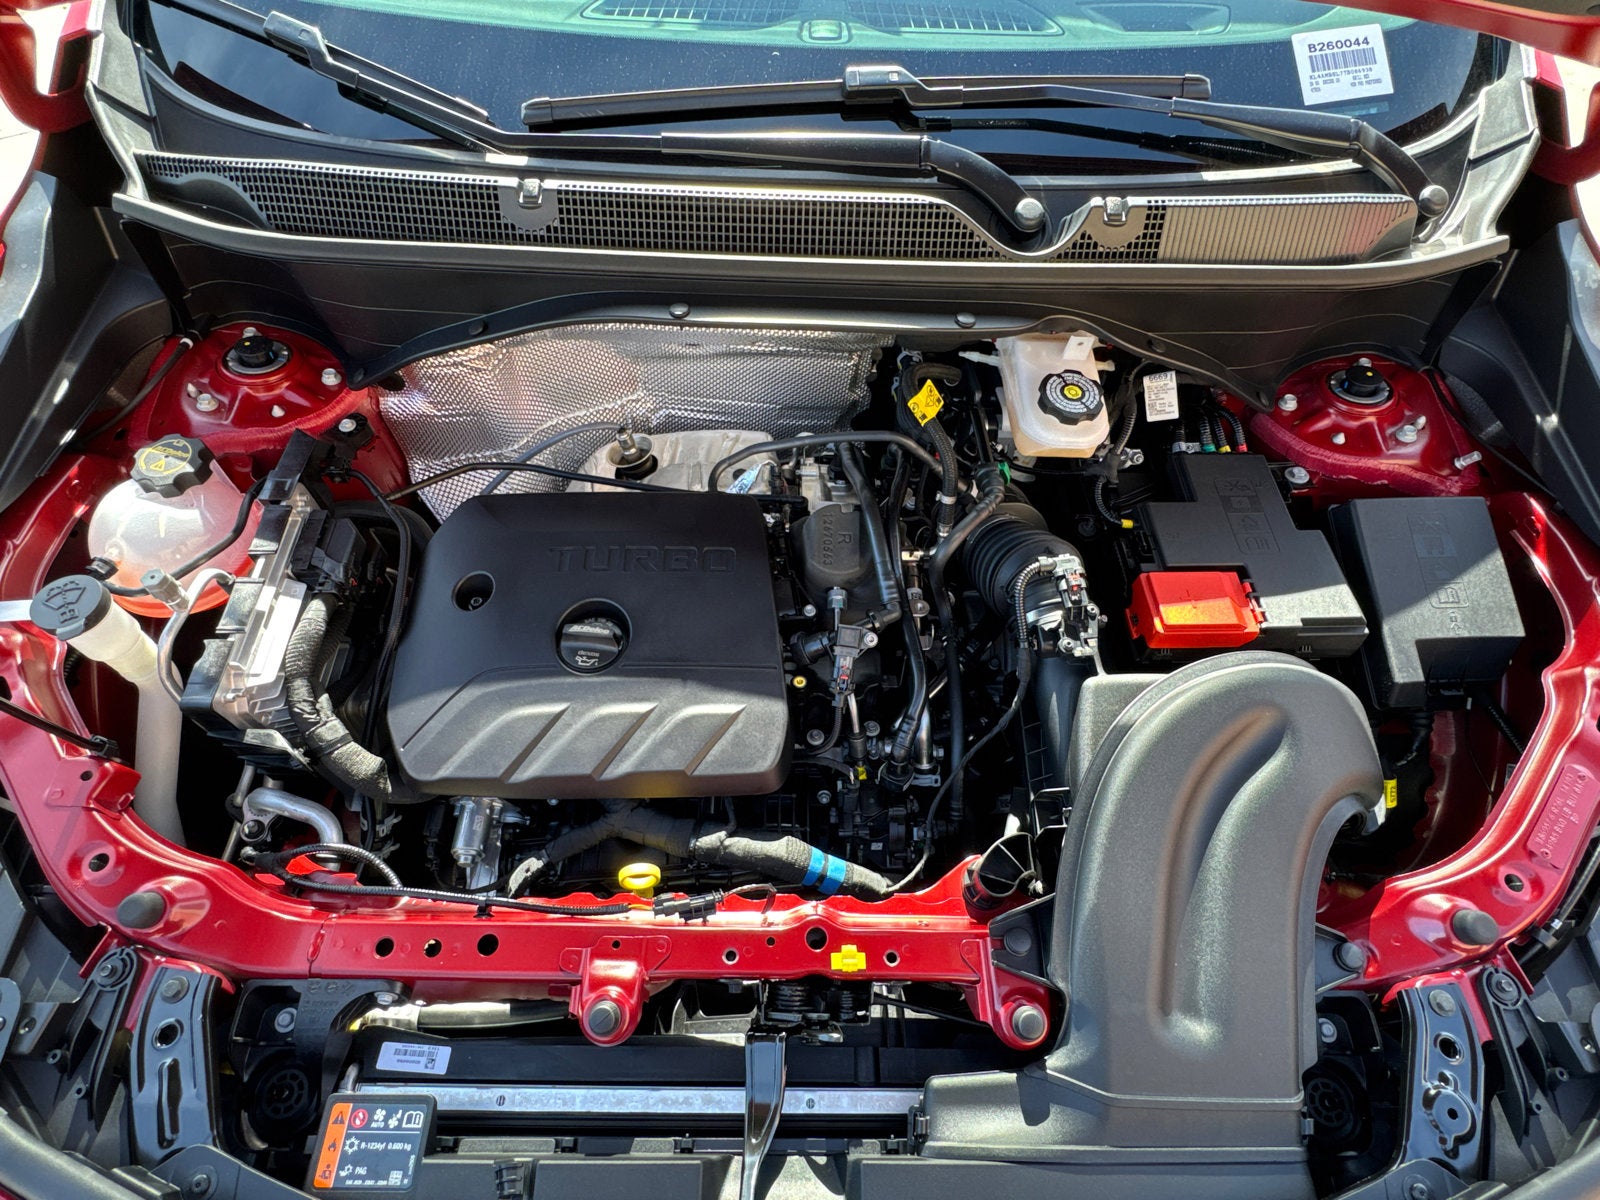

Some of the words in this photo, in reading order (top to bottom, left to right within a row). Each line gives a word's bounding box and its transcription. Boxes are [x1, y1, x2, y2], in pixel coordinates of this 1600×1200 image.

[1308, 36, 1370, 53] B260044
[822, 513, 833, 566] 12670663
[837, 531, 853, 545] R
[549, 545, 737, 573] TURBO
[568, 625, 610, 634] ACDelco
[360, 1142, 386, 1151] R-1234yf
[387, 1142, 404, 1150] 0.600
[404, 1142, 412, 1151] kg
[355, 1166, 367, 1175] PAG
